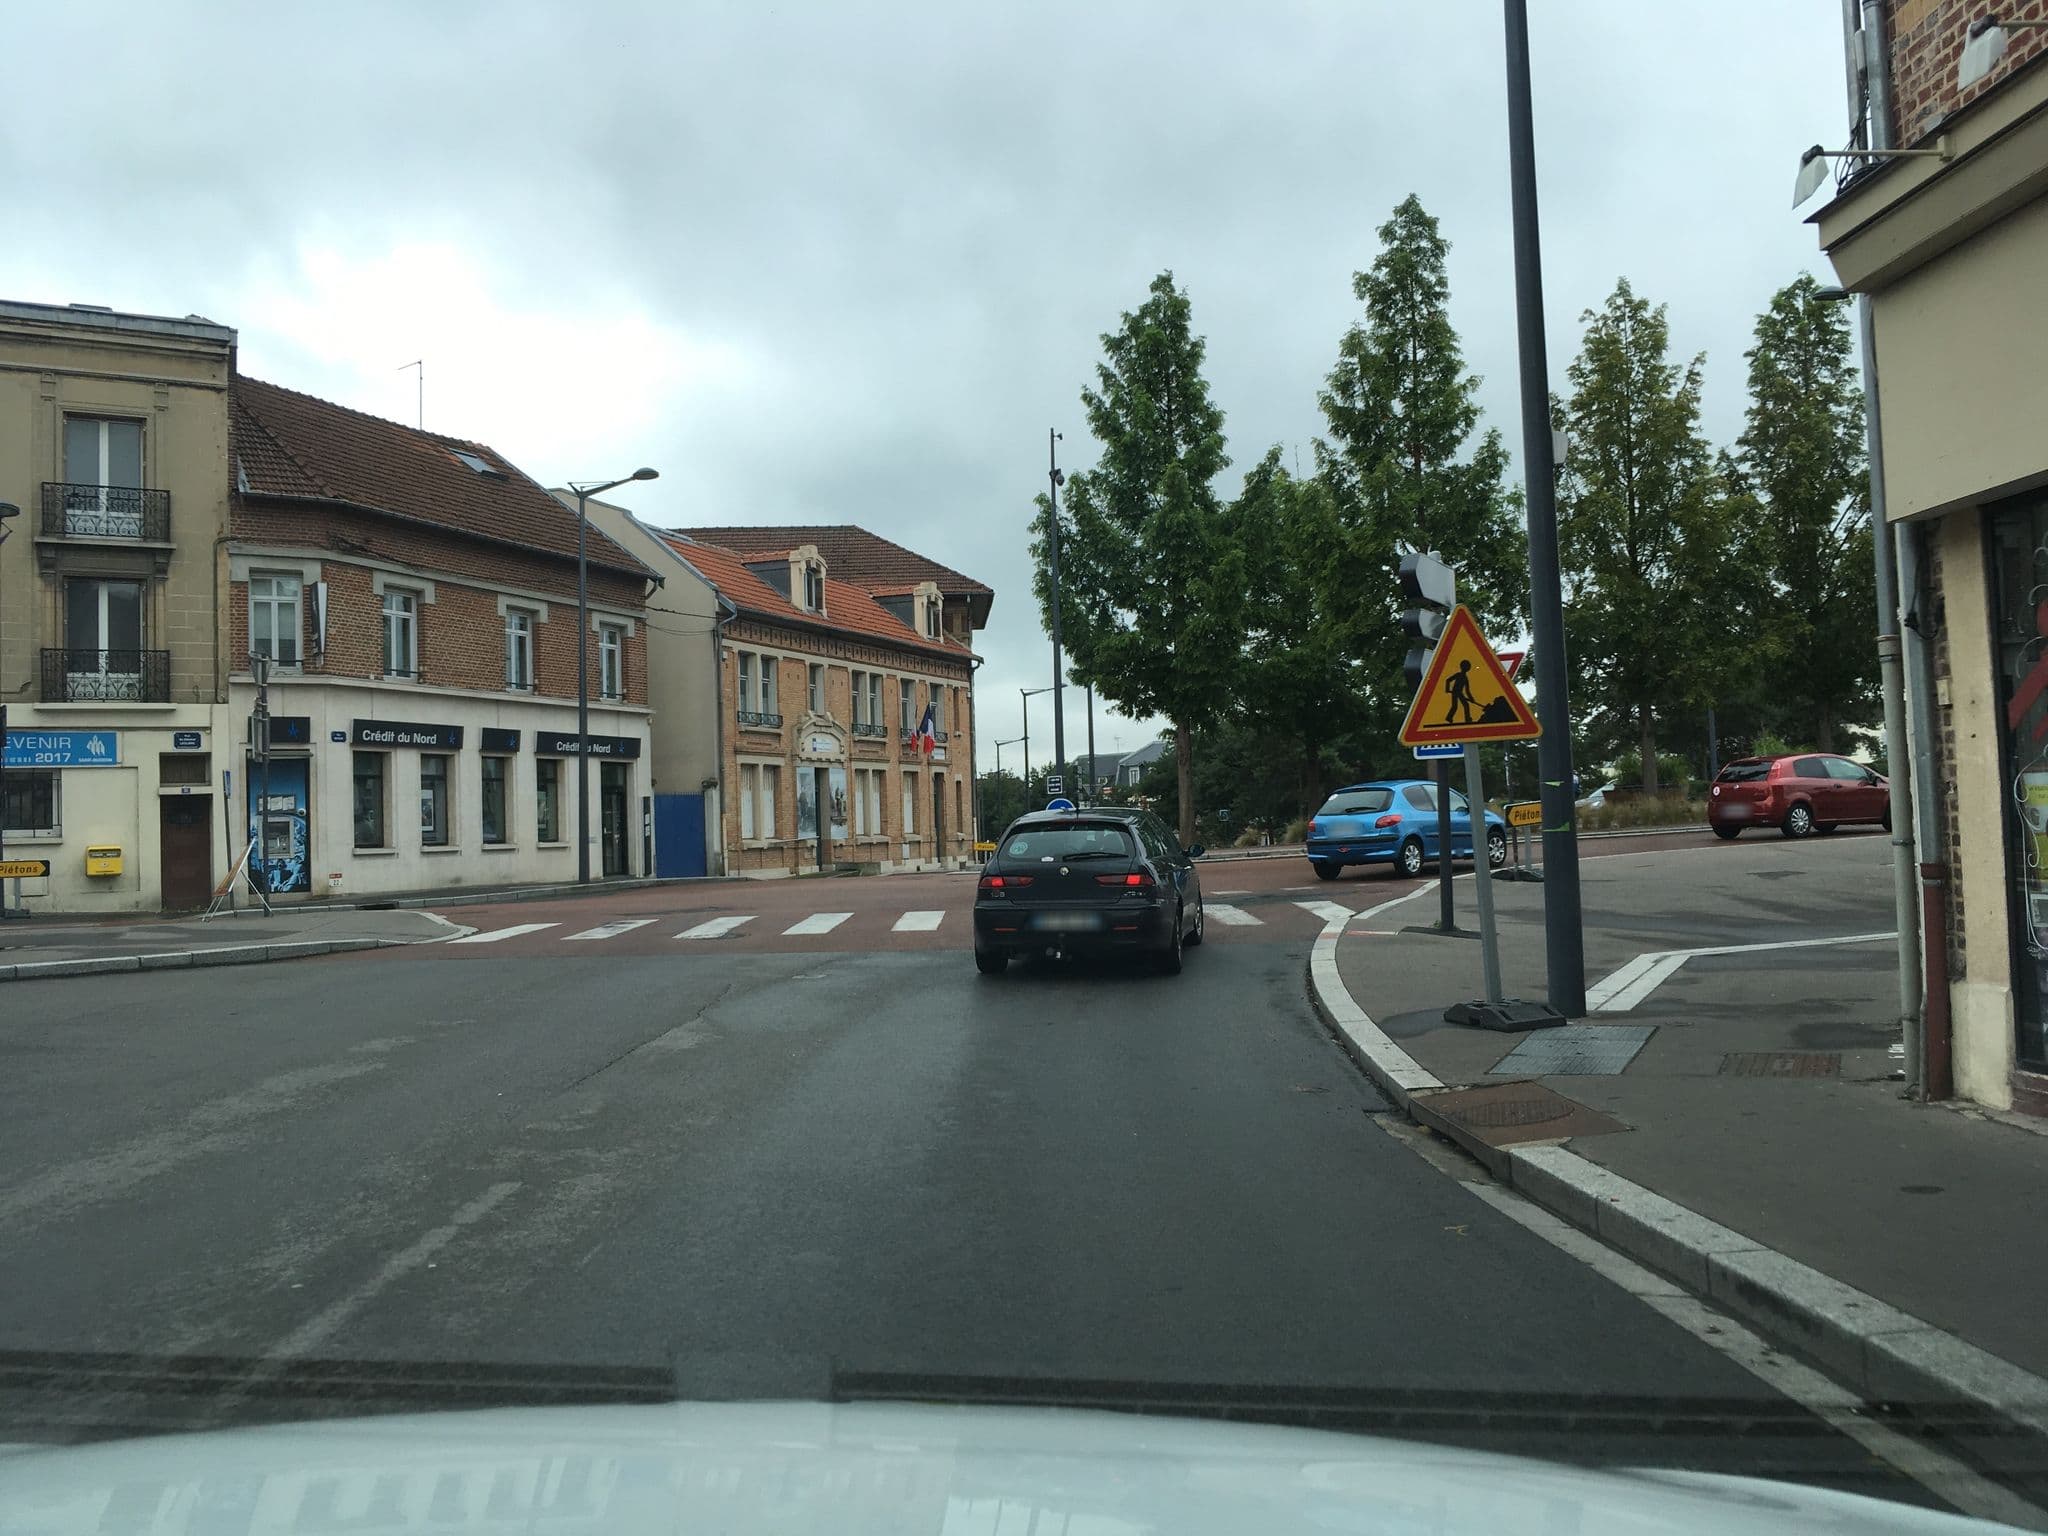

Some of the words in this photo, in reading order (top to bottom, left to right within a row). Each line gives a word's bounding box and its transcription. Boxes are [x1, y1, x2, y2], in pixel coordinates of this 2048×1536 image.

[362, 730, 395, 742] Crédit
[397, 732, 411, 743] du
[413, 733, 437, 744] Nord
[592, 743, 611, 753] Nord
[35, 752, 71, 763] 2017
